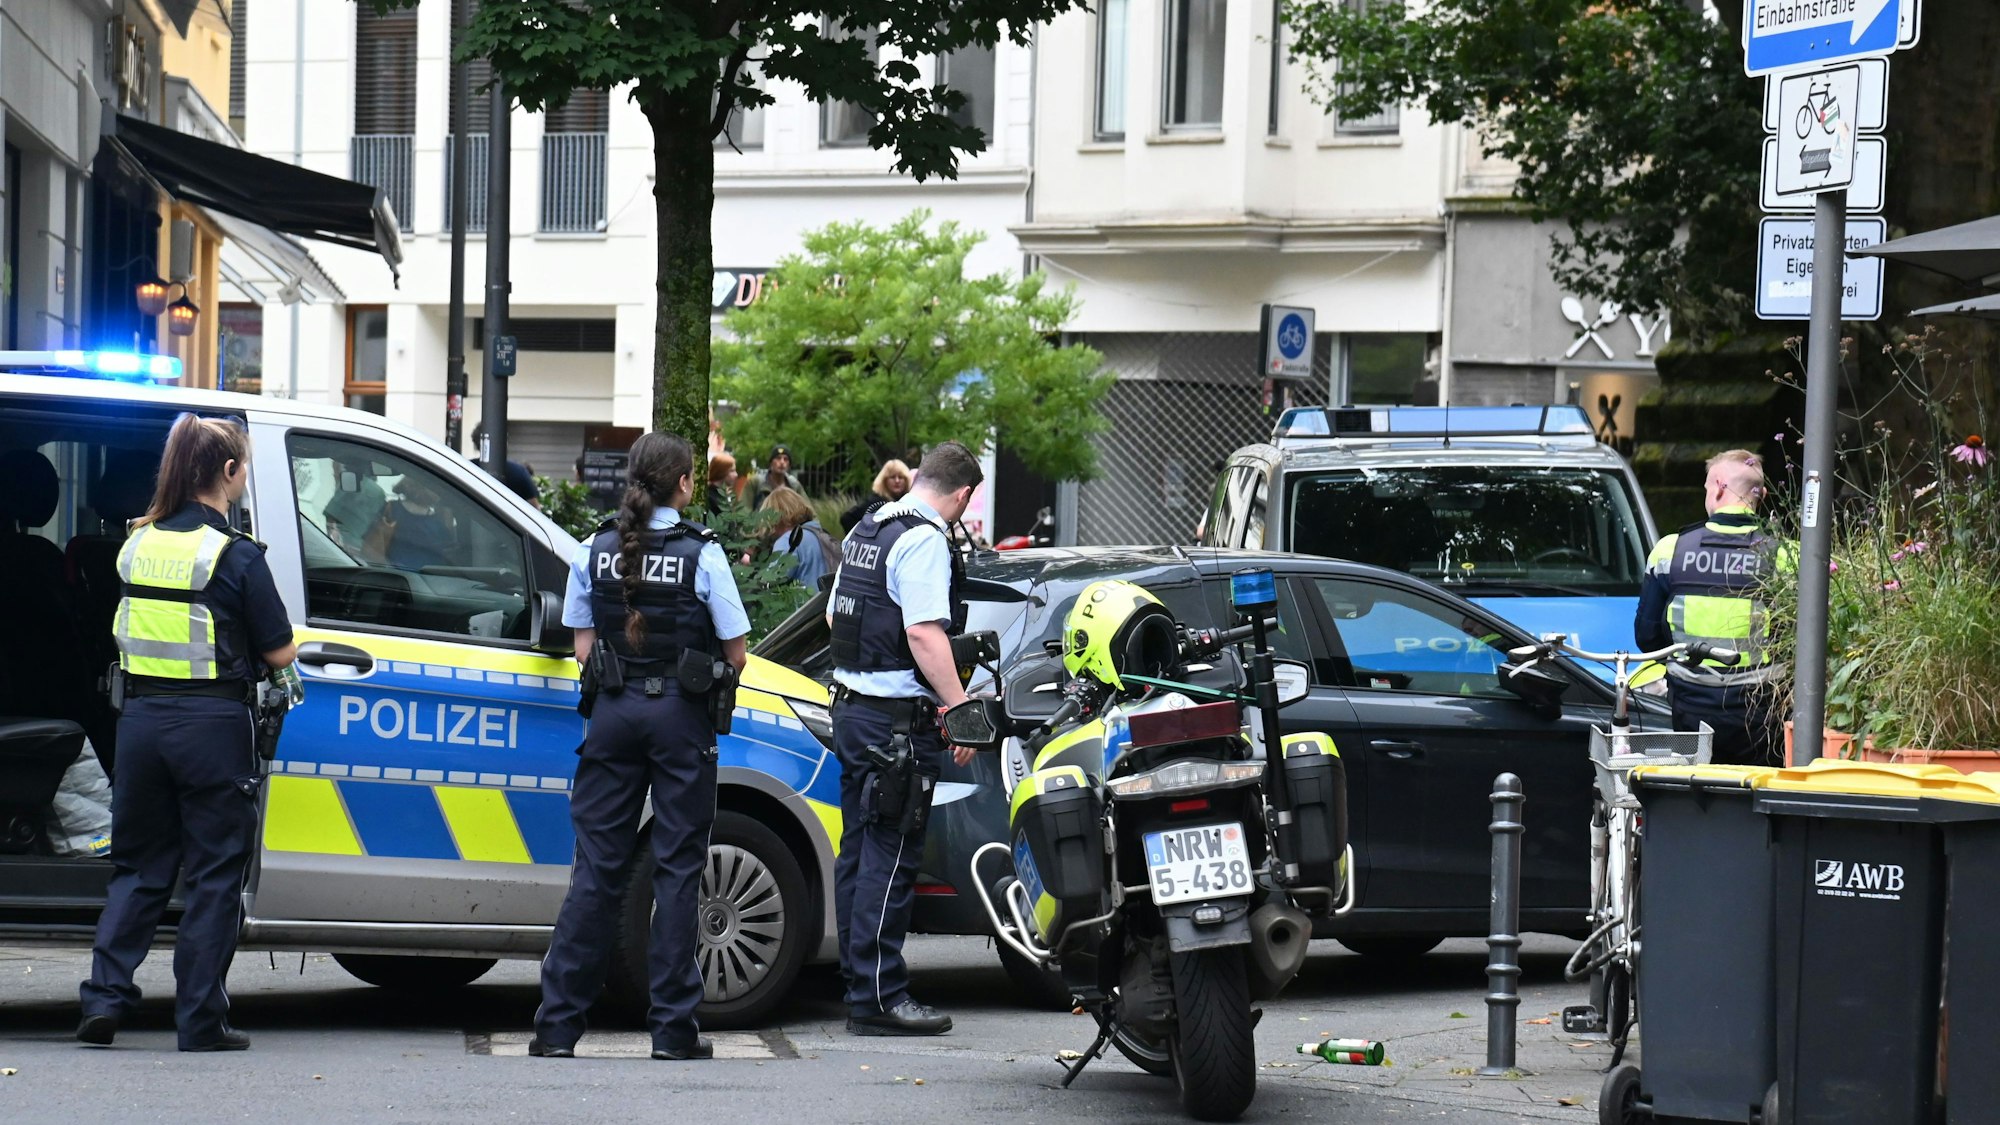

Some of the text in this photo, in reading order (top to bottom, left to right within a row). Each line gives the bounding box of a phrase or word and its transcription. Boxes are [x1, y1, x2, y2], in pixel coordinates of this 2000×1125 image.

[1757, 0, 1855, 29] Einbahnstraße
[1807, 493, 1815, 513] Huel
[132, 557, 193, 580] POLIZEI
[597, 552, 684, 583] POIZEI
[1682, 551, 1761, 575] POLIZEI
[836, 595, 855, 616] NRW
[339, 695, 519, 749] POLIZEI
[1163, 829, 1223, 863] NRW
[1155, 860, 1248, 897] 5-438
[1845, 862, 1905, 891] AWB
